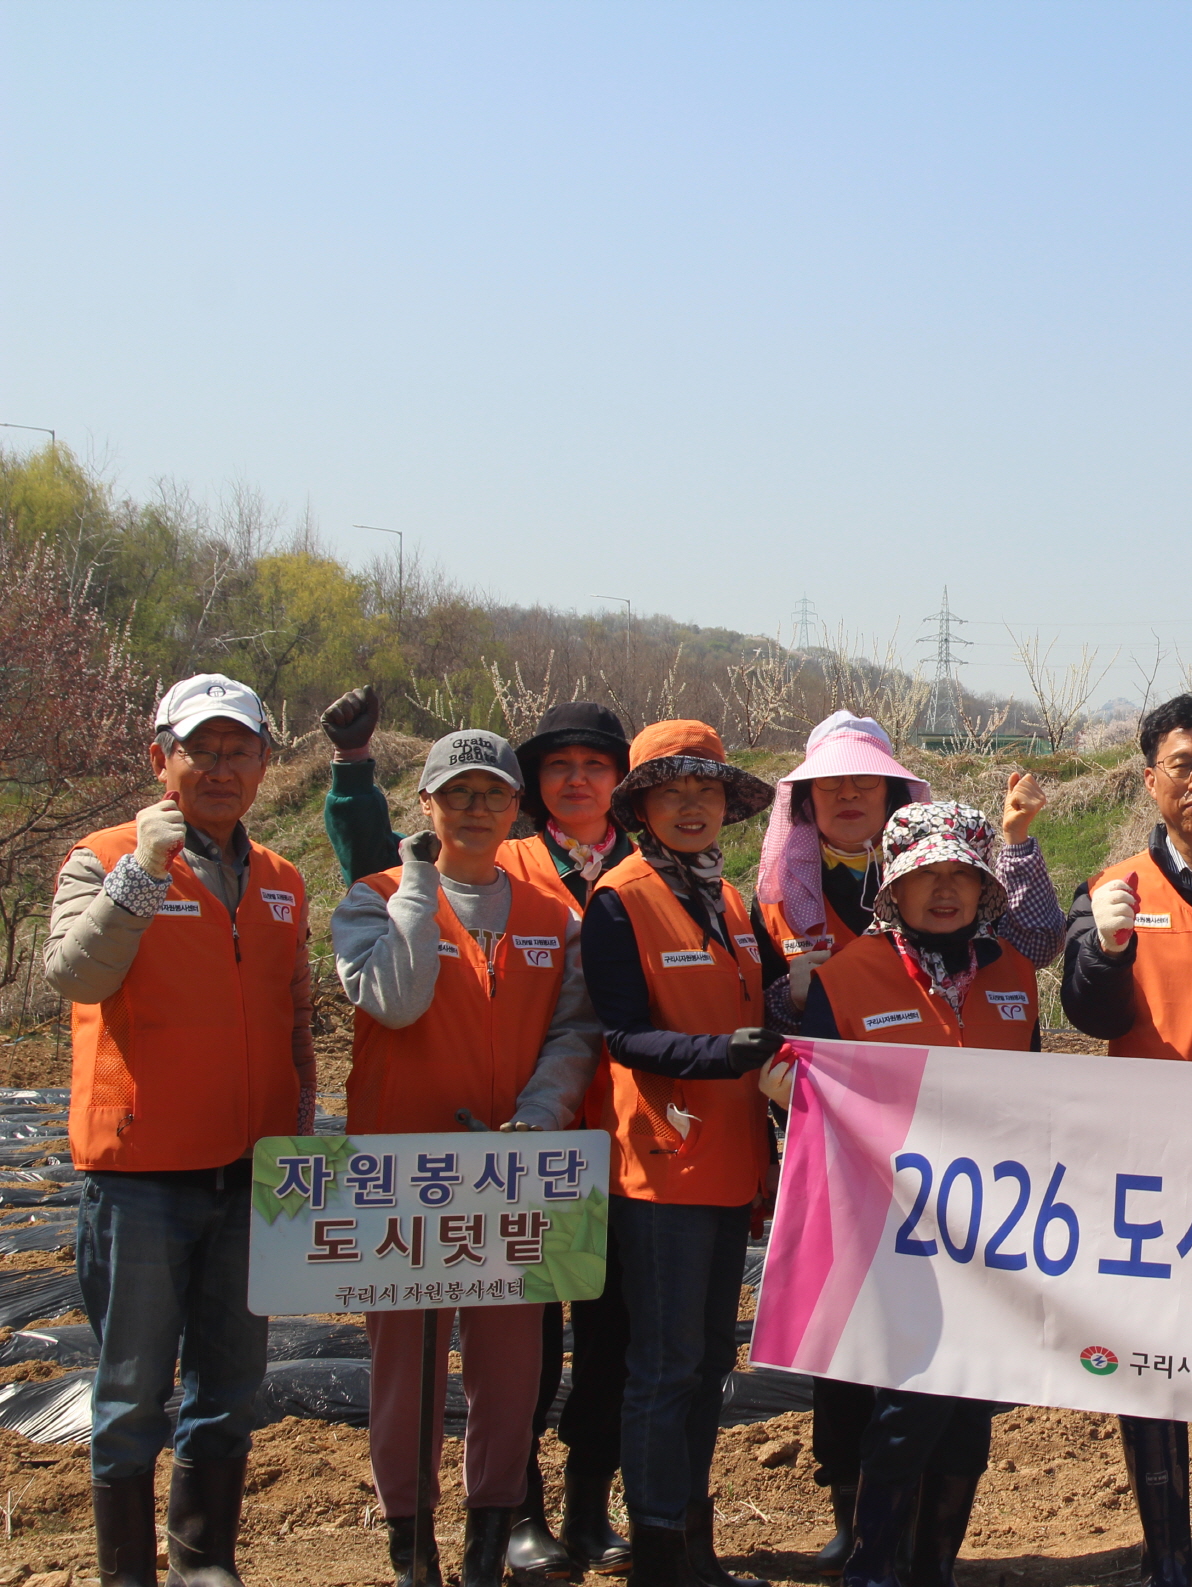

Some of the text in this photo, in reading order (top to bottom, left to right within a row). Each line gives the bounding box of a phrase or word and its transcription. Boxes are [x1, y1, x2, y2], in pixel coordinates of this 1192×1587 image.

[452, 737, 493, 749] Grain
[462, 744, 482, 755] De
[273, 1148, 587, 1210] 자원봉사단
[894, 1151, 1080, 1277] 2026
[305, 1210, 550, 1268] 도시텃밭
[334, 1277, 526, 1307] 구리시 자원봉사센터
